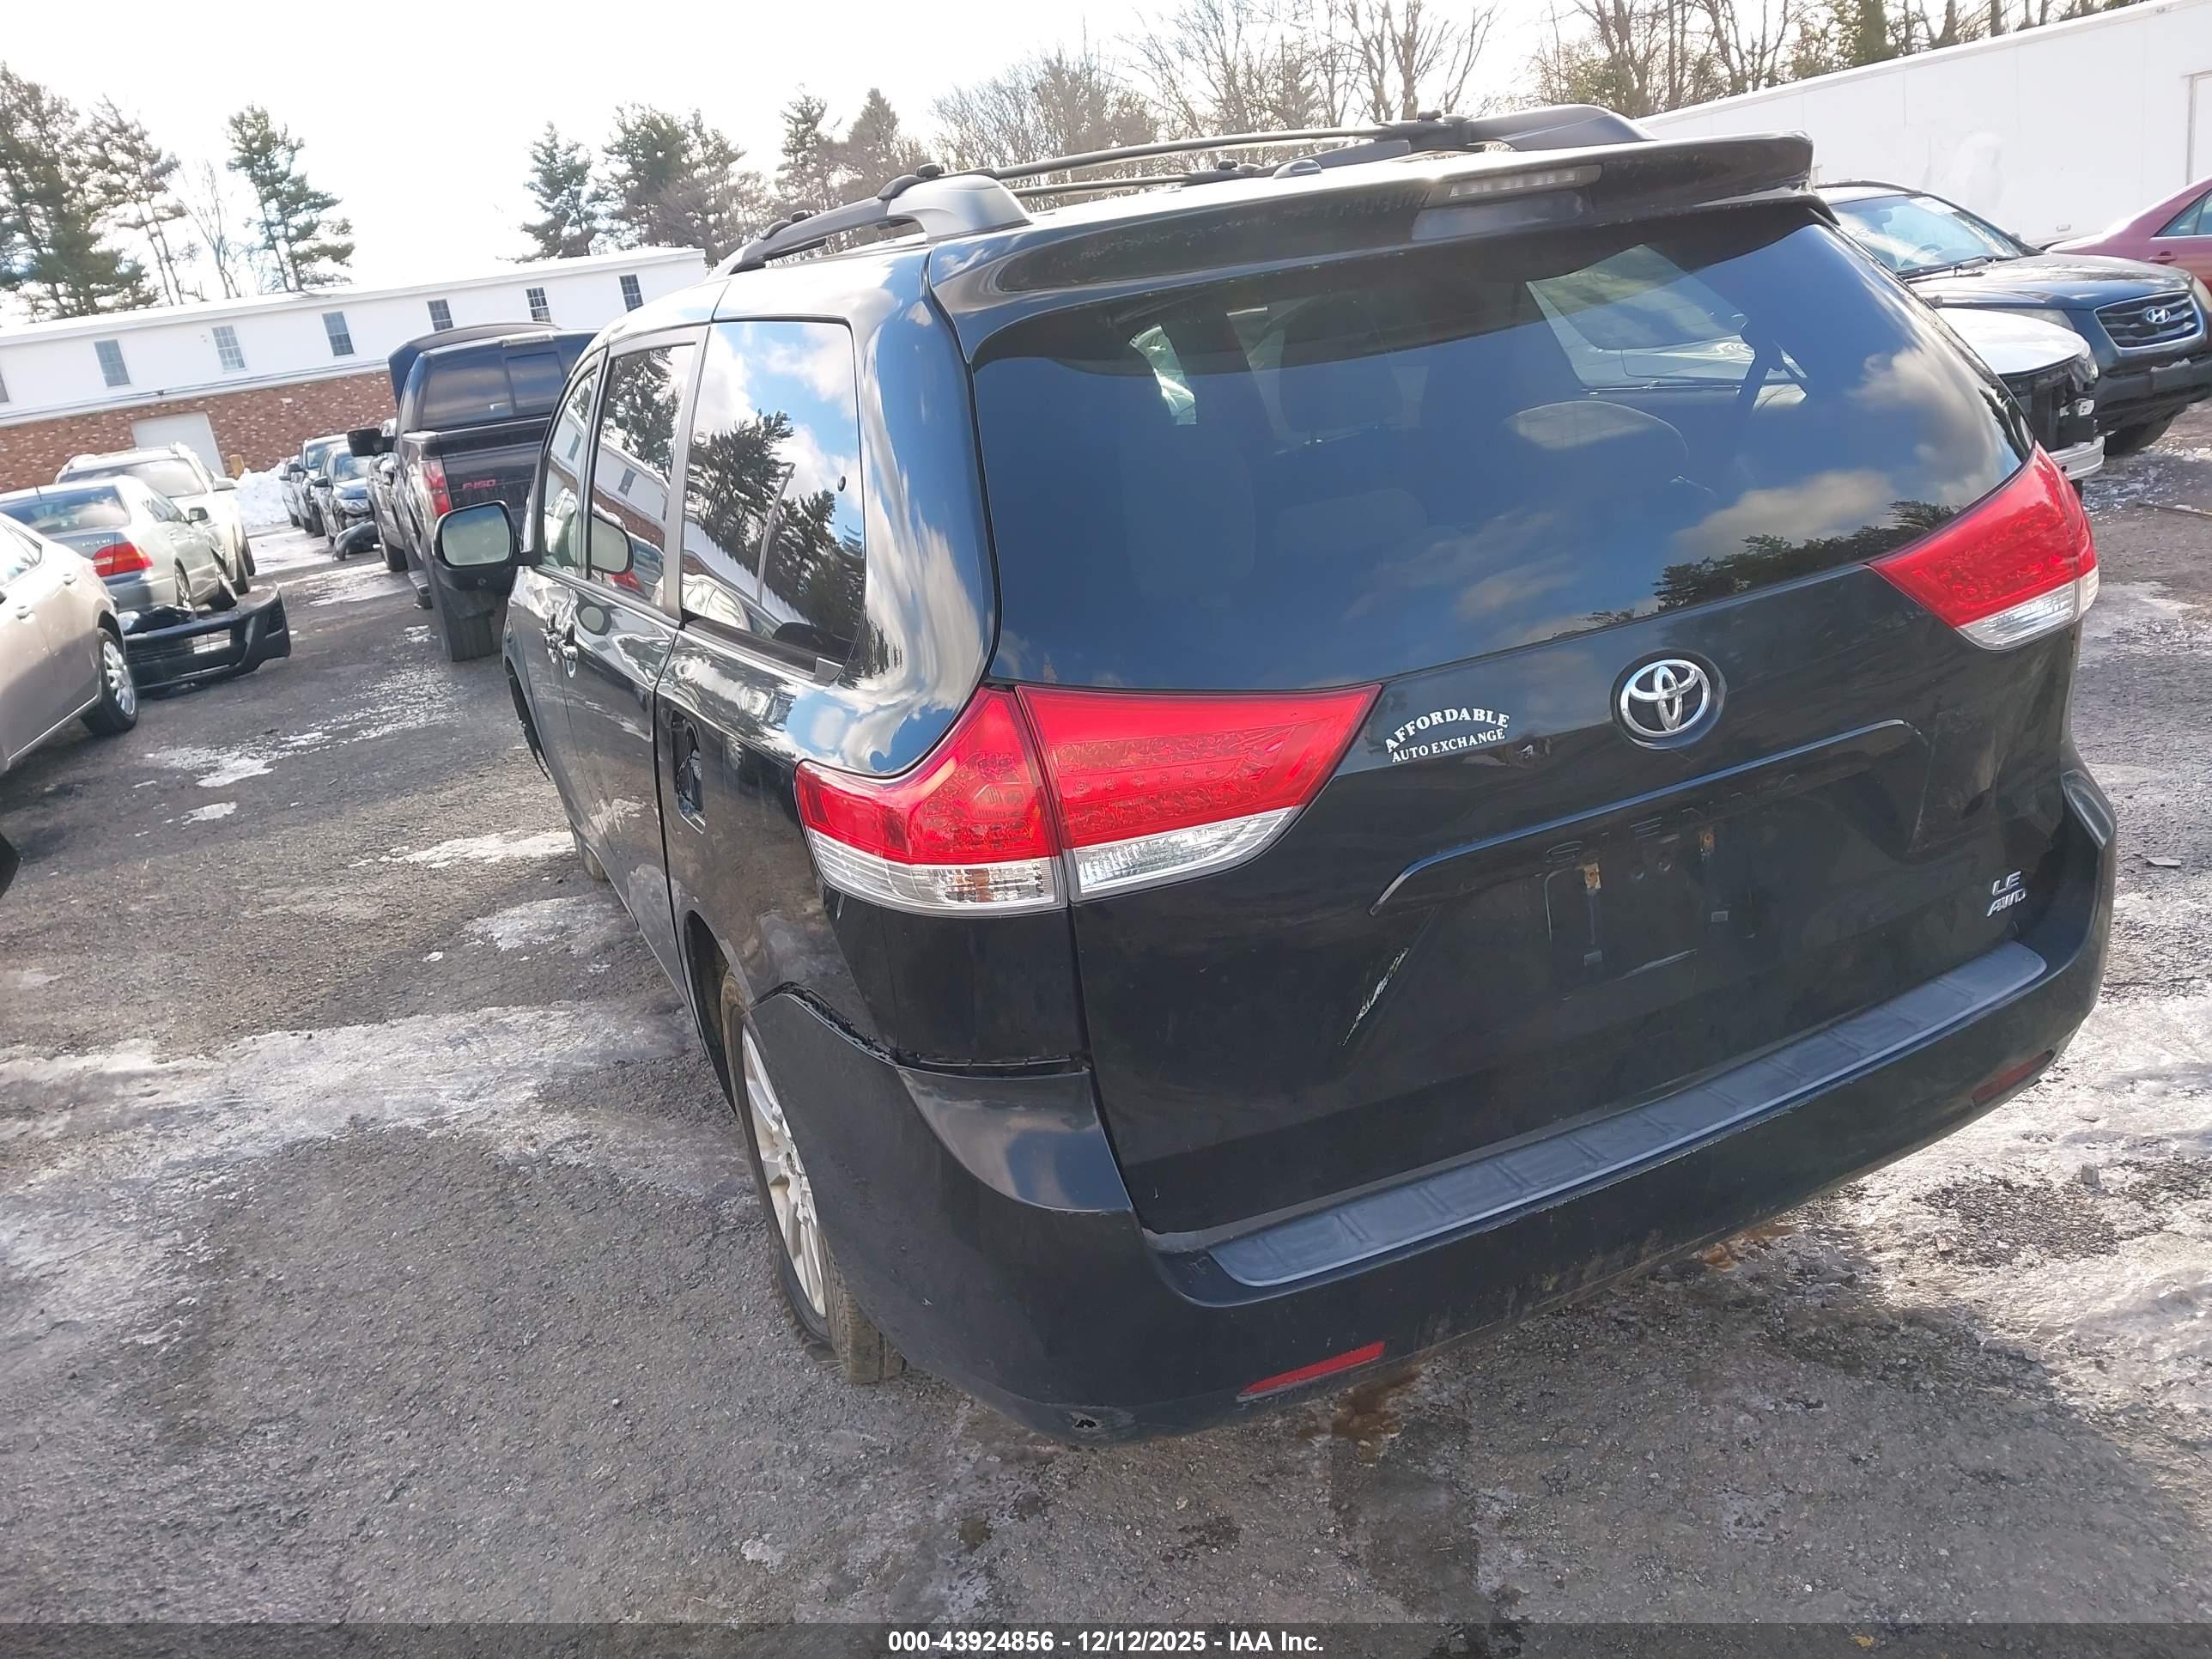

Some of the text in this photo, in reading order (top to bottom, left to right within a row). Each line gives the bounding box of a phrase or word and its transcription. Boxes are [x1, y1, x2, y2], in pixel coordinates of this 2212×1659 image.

[1384, 708, 1510, 753] AFFORDABLE
[1391, 727, 1505, 763] AUTO EXCHANGE
[1992, 870, 2021, 896] LE
[1986, 888, 2027, 917] AWD
